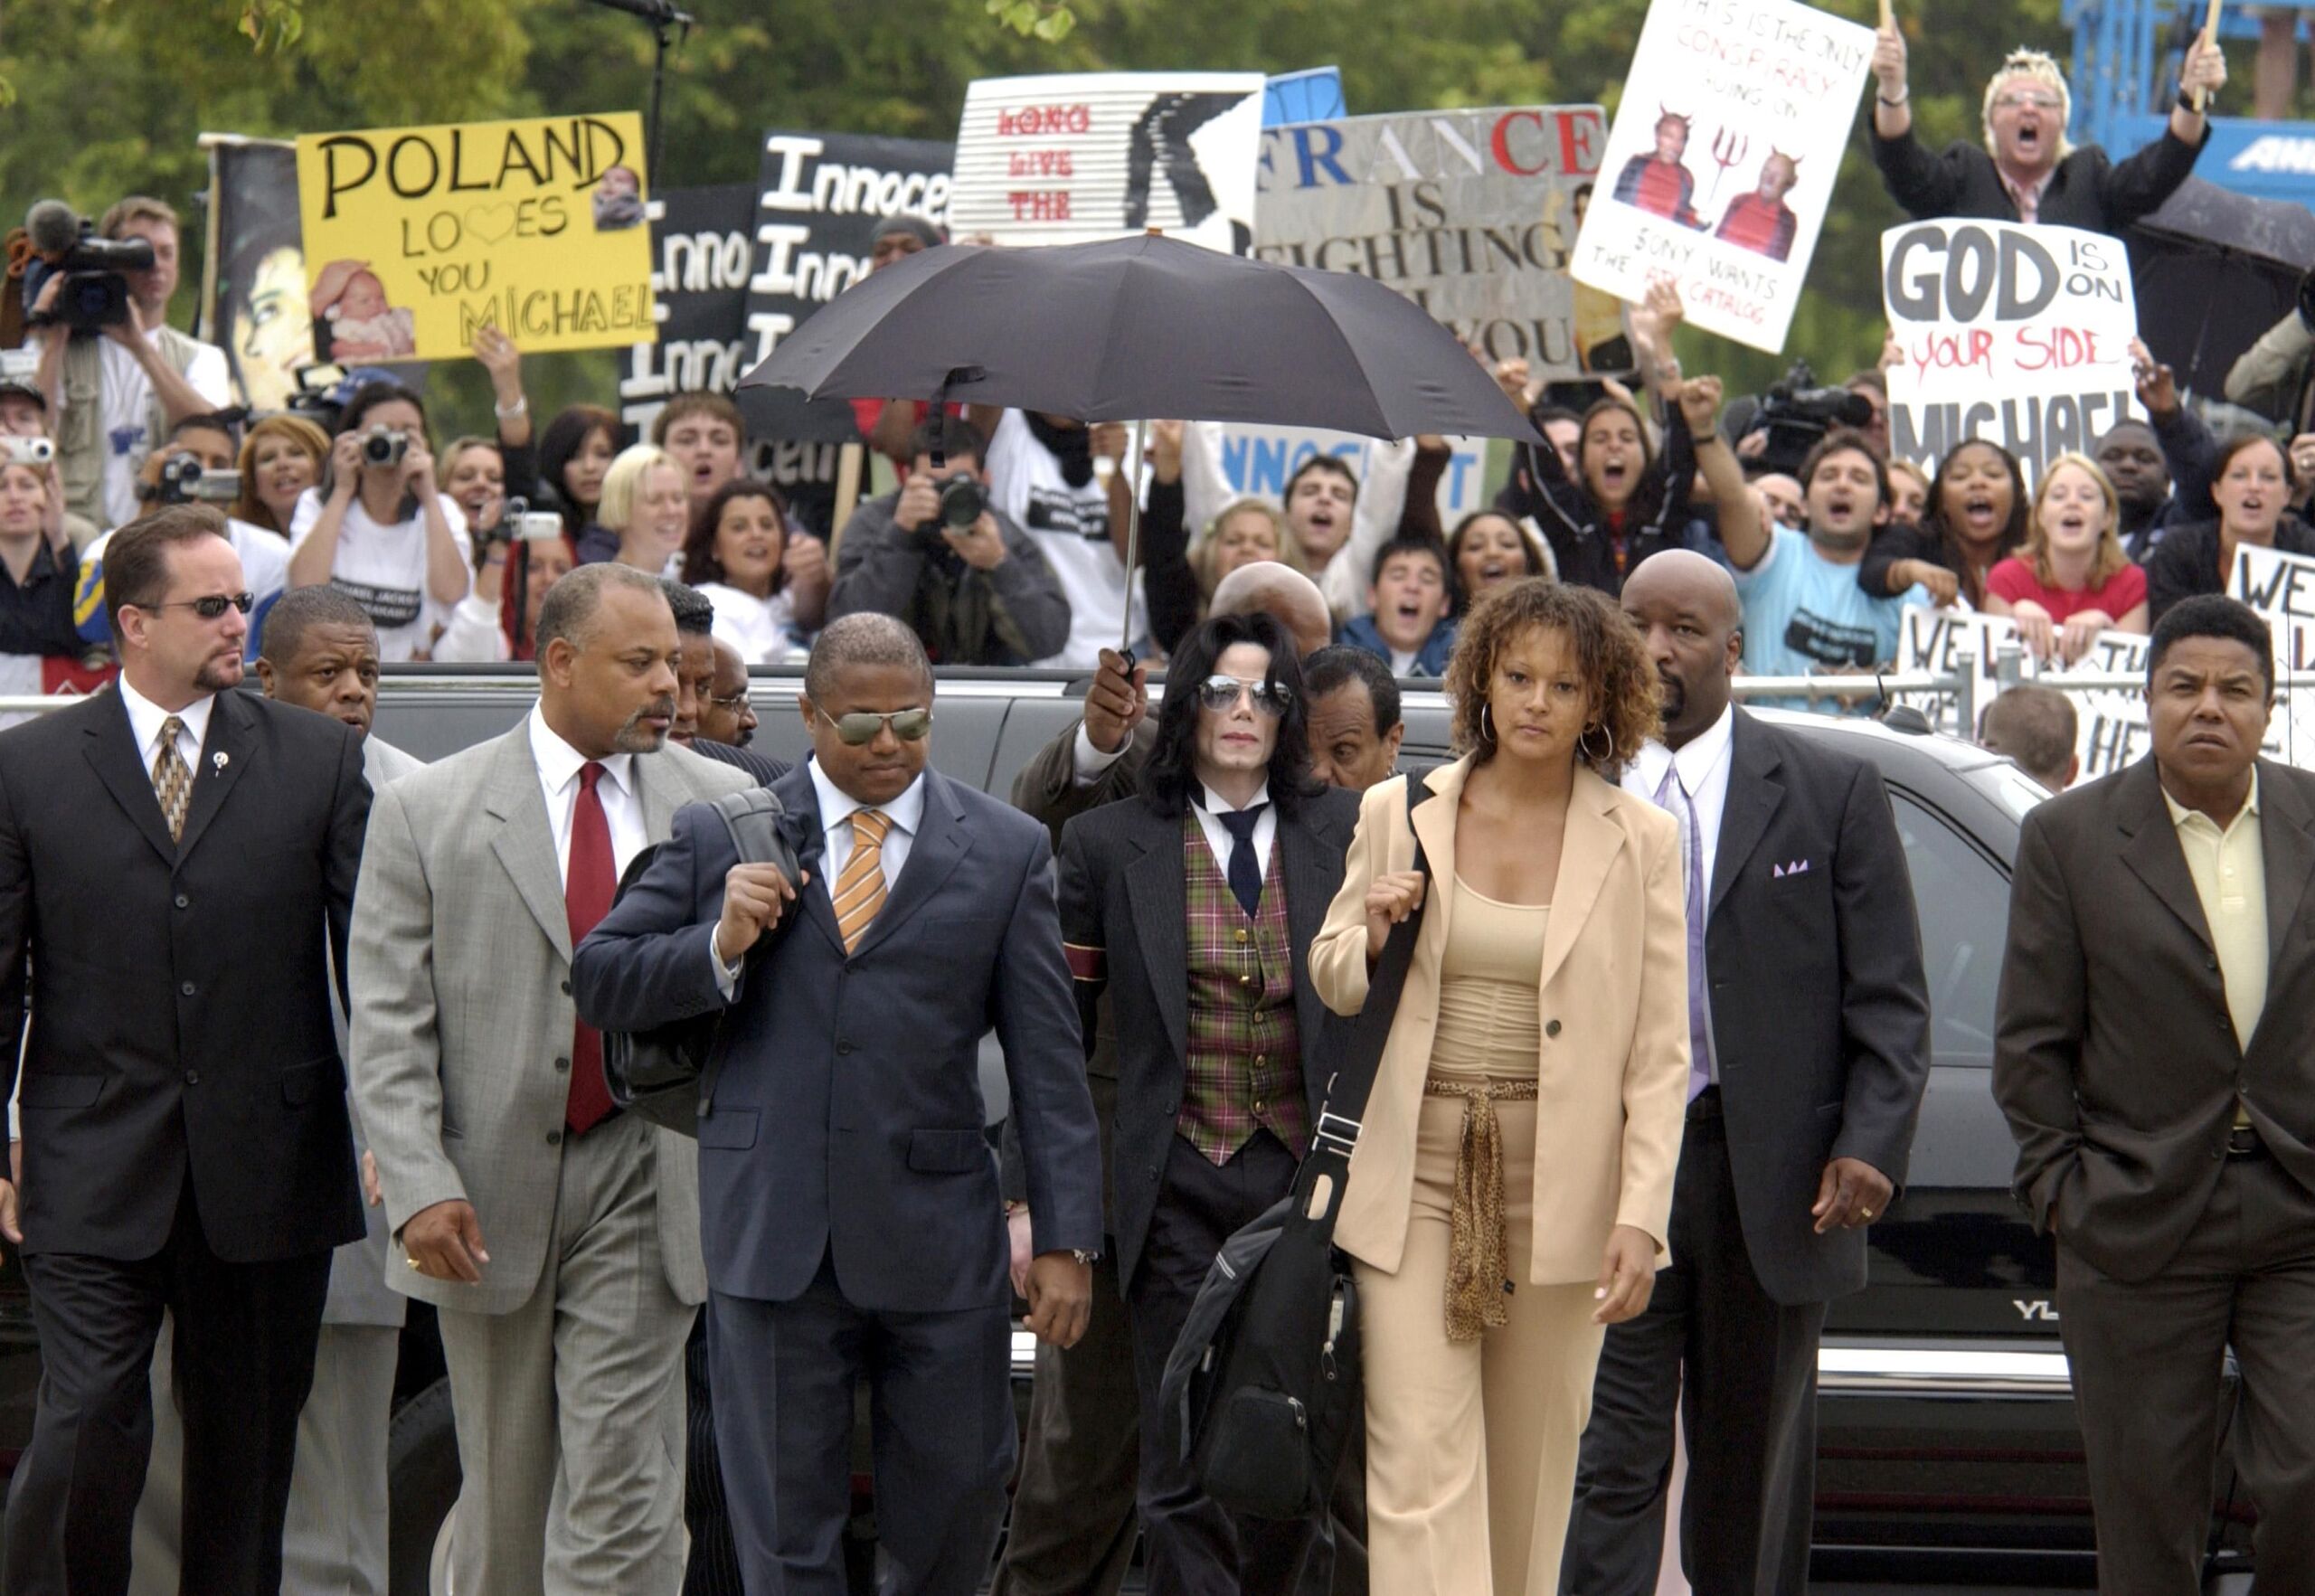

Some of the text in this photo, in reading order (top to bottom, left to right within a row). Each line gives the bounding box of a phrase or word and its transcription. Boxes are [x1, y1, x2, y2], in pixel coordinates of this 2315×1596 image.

[1775, 18, 1811, 52] THE
[317, 118, 624, 220] POLAND
[1007, 150, 1073, 177] LIVE
[1007, 191, 1072, 221] THE
[1384, 183, 1446, 231] IS
[418, 260, 490, 297] YOU
[1592, 244, 1630, 274] THE
[1709, 256, 1780, 300] WANTS
[1886, 224, 2109, 324] GOD IS
[2065, 272, 2124, 304] ON
[459, 283, 654, 347] MICHAEL
[1911, 326, 2121, 389] YOUR SIDE
[2239, 552, 2315, 619] WE
[1910, 614, 1968, 673] WE
